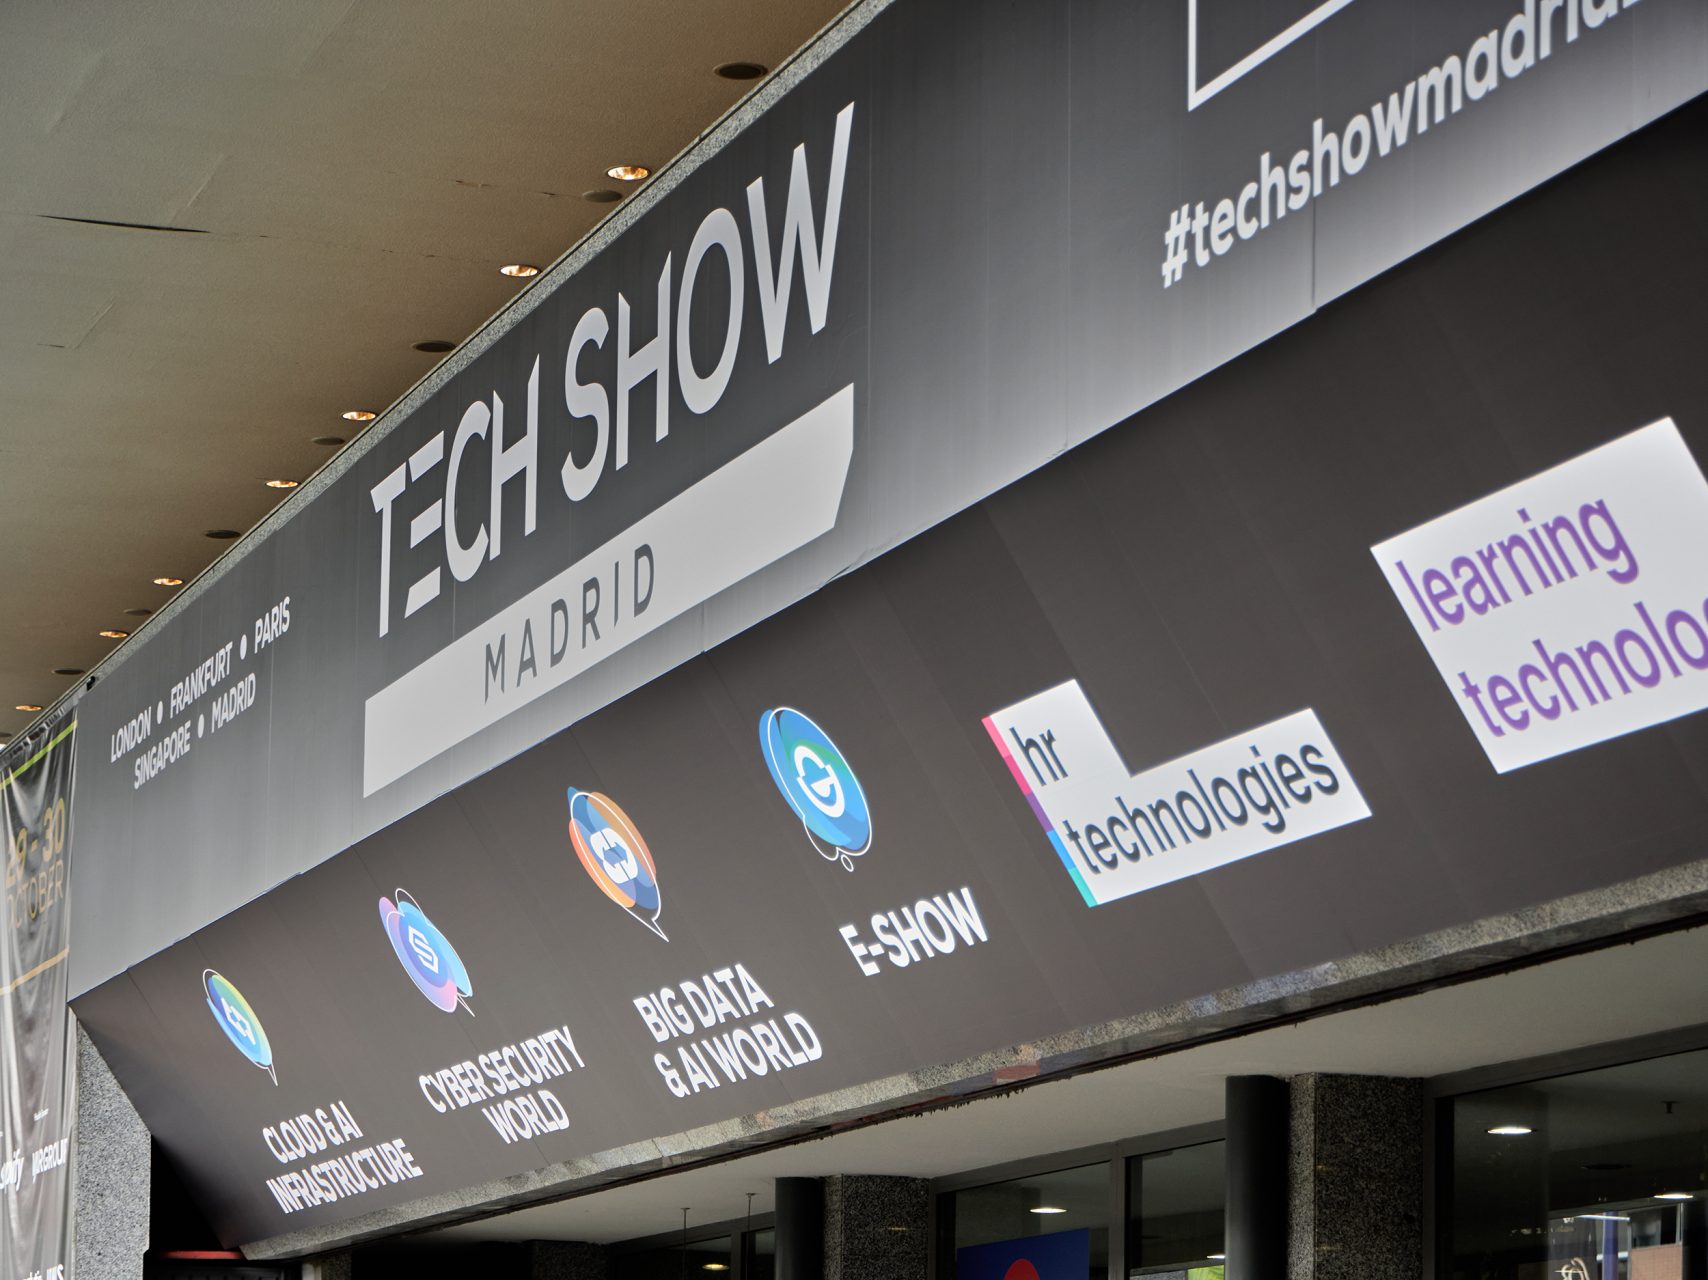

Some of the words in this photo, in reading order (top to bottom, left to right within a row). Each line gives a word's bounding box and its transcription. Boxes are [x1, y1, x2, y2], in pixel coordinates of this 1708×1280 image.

[1161, 0, 1642, 289] #techshowmadri
[371, 354, 540, 638] TECH
[561, 101, 855, 502] SHOW
[1395, 498, 1640, 632] learning
[484, 543, 656, 704] MADRID
[1457, 597, 1708, 738] technolo
[111, 706, 152, 764] LONDON
[170, 641, 233, 719] FRANKFURT
[254, 596, 290, 654] PARIS
[134, 720, 192, 790] SINGAPORE
[211, 672, 256, 734] MADRID
[1008, 726, 1069, 787] hr
[42, 797, 65, 862] 30
[1062, 744, 1340, 875] technologies
[838, 886, 989, 977] E-SHOW
[633, 987, 695, 1043] BIG
[679, 963, 775, 1029] DATA
[653, 1053, 691, 1098] &
[677, 1042, 721, 1094] AI
[701, 1011, 823, 1083] WORLD
[262, 1113, 328, 1164] CLOUD
[314, 1107, 344, 1146] &
[329, 1100, 365, 1142] AI
[481, 1089, 570, 1145] WORLD
[265, 1138, 424, 1215] INFRASTRUCTURE
